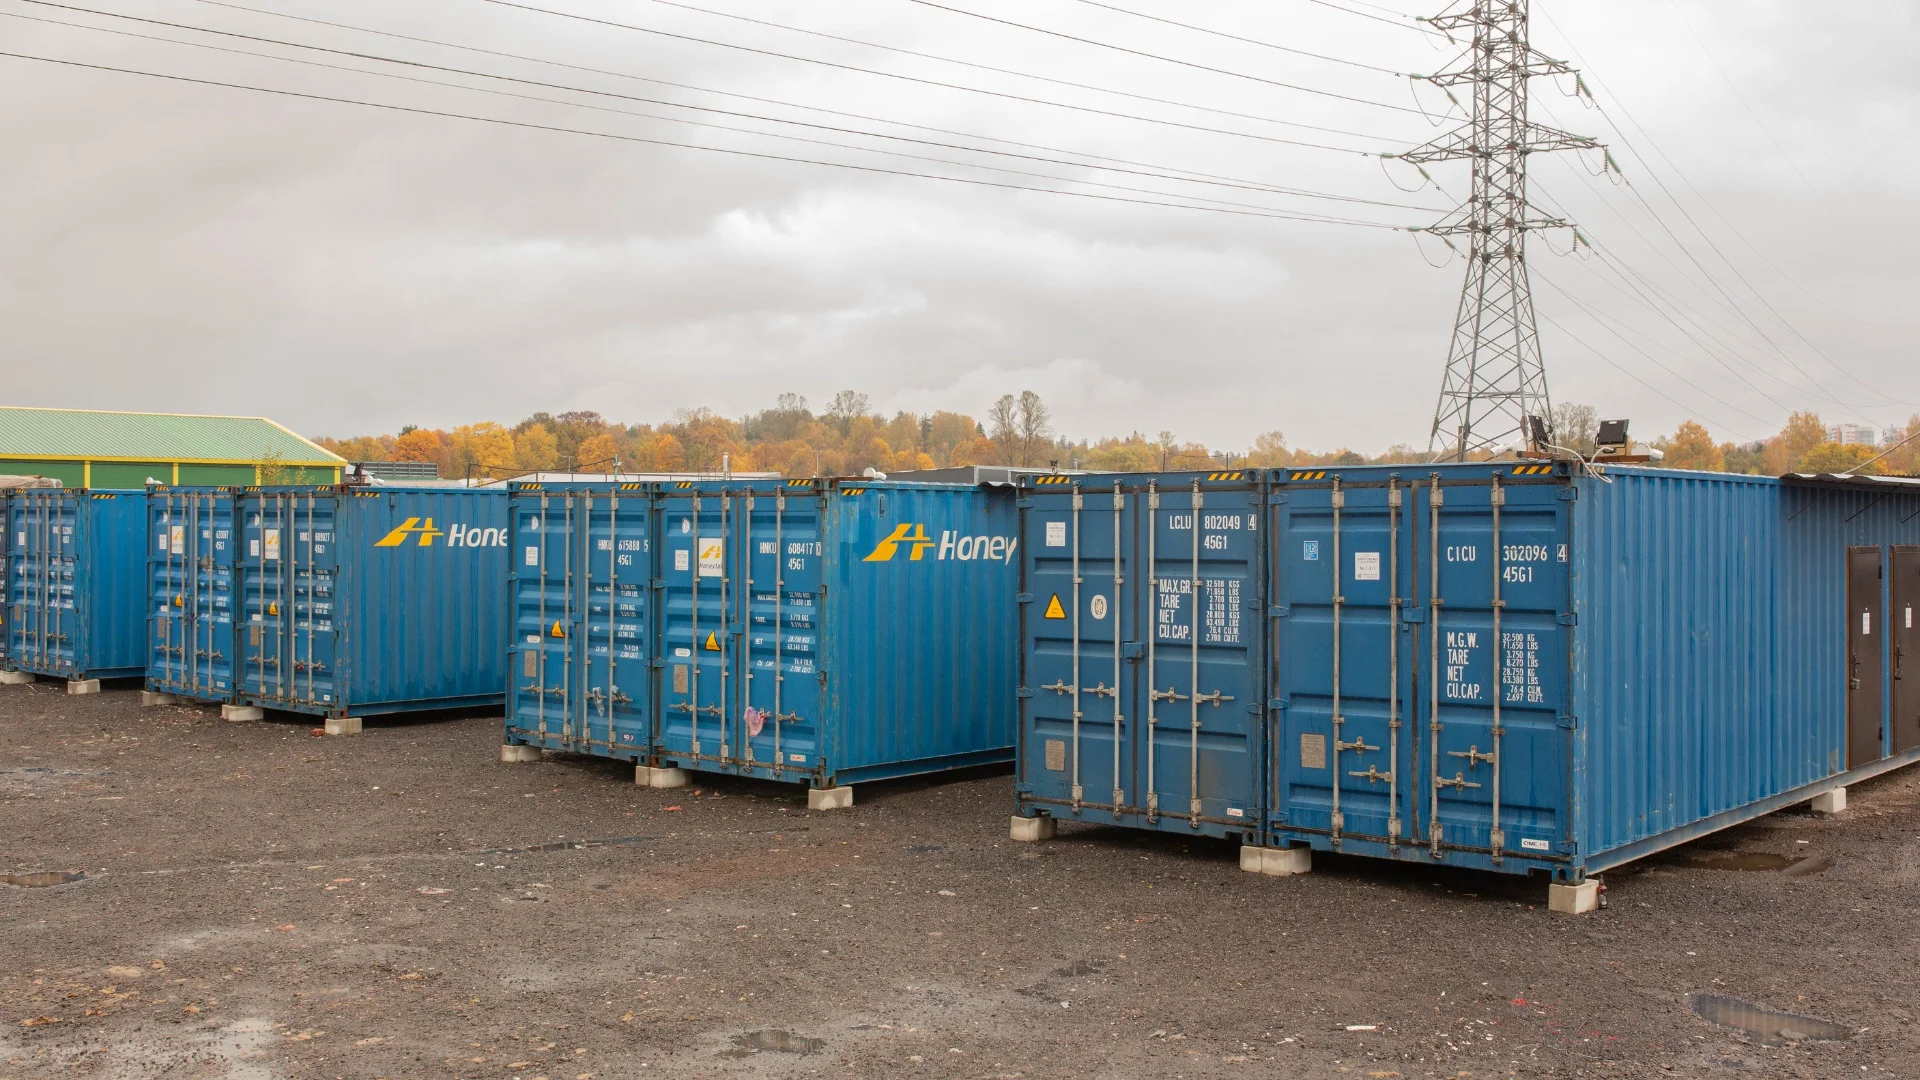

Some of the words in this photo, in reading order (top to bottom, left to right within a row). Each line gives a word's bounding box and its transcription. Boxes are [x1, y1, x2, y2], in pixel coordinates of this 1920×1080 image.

[1169, 516, 1192, 530] LCLU
[1204, 516, 1240, 530] 802049
[788, 543, 814, 554] 608417
[1204, 535, 1228, 550] 45G1
[618, 555, 632, 566] 45G1
[1447, 546, 1476, 562] CICU
[1502, 546, 1548, 561] 302096
[1558, 545, 1567, 562] 4
[788, 558, 804, 570] 45G1
[1502, 566, 1532, 582] 45G1
[1160, 579, 1192, 594] MAX.GR.
[1160, 594, 1180, 608] TARE
[1160, 609, 1175, 623] NET
[1159, 624, 1191, 640] CU.CAP.
[1447, 632, 1479, 648] M.G.W.
[1448, 649, 1469, 664] TARE
[1448, 666, 1464, 681] NET
[1527, 668, 1535, 676] KG
[1527, 676, 1538, 684] LBS
[1447, 683, 1482, 699] CU.CAP.
[1510, 685, 1523, 693] 76.4
[1506, 693, 1523, 701] 2.697
